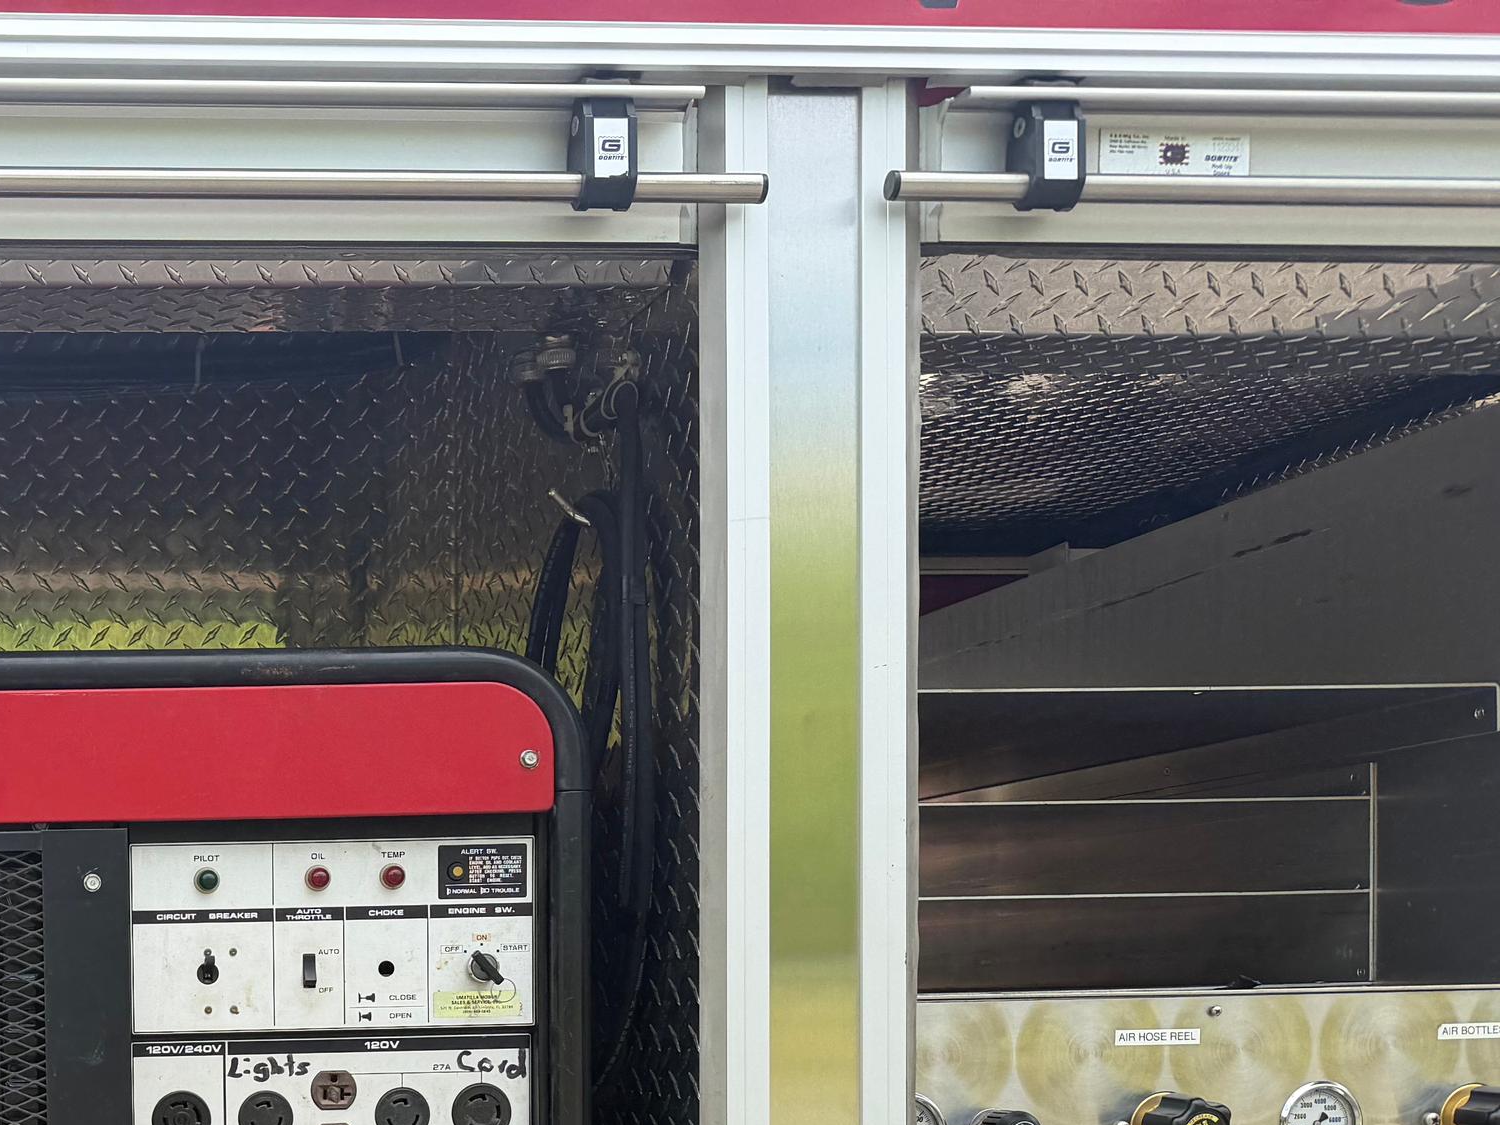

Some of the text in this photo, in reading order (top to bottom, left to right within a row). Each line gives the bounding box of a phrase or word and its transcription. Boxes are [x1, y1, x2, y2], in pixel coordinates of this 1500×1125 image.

[193, 854, 220, 862] PILOT
[311, 852, 326, 860] OIL
[368, 908, 405, 916] CHOKE
[1442, 1026, 1459, 1035] AIR
[1118, 1031, 1197, 1042] AIR HOSE REEL
[145, 1044, 222, 1054] 120V/240V
[363, 1040, 400, 1050] 120V
[227, 1053, 311, 1082] Lights
[432, 1063, 451, 1071] 27A
[457, 1047, 527, 1080] Cord
